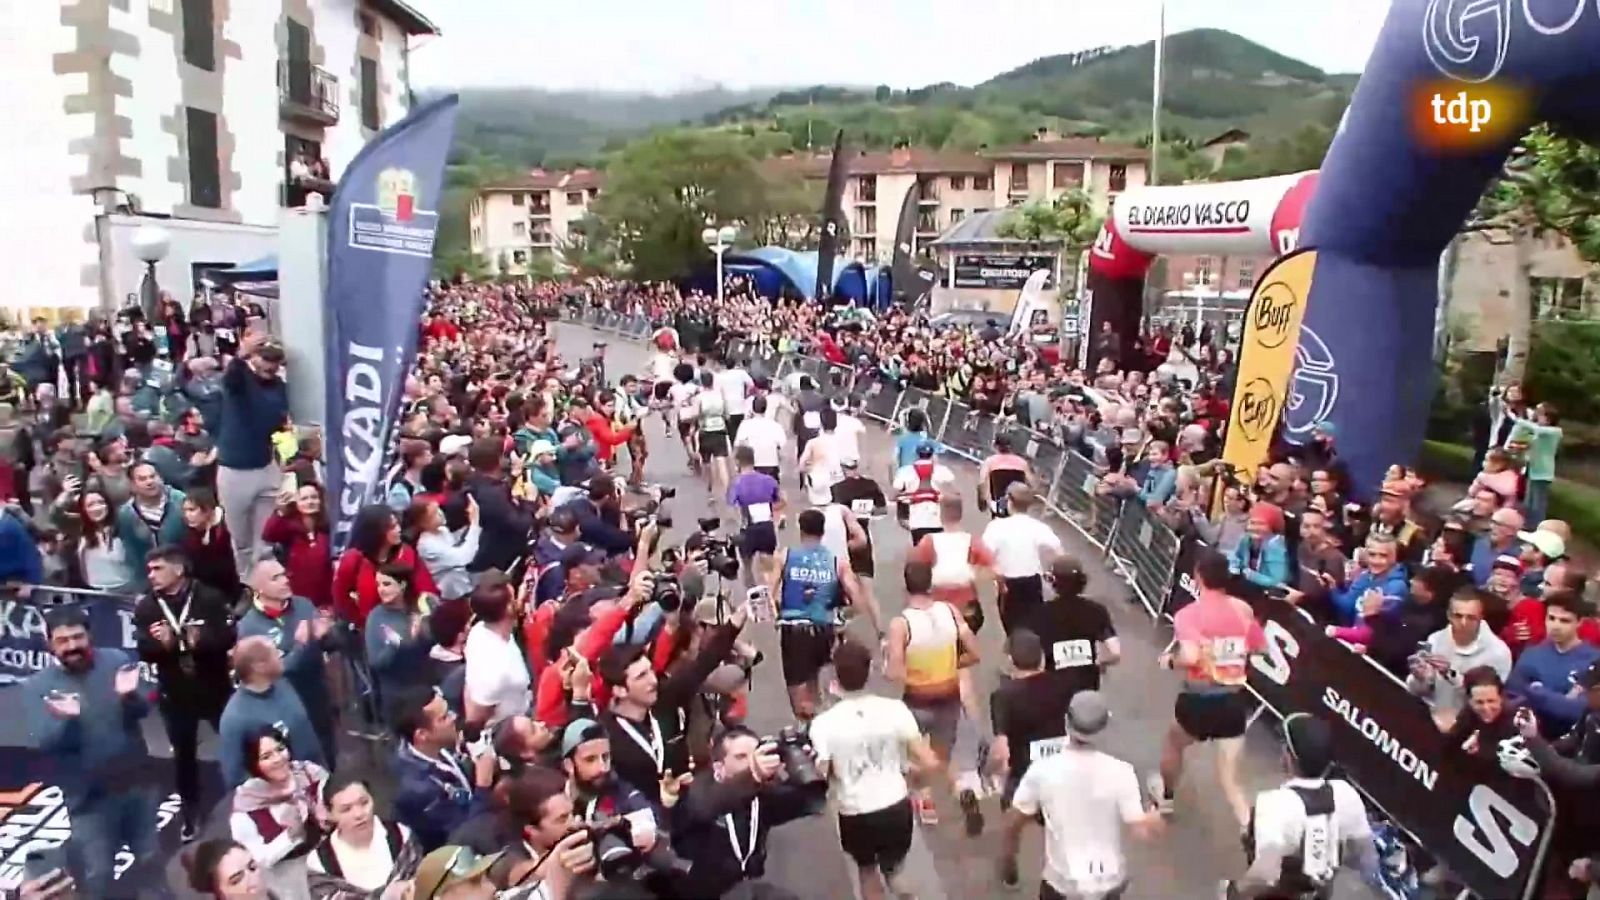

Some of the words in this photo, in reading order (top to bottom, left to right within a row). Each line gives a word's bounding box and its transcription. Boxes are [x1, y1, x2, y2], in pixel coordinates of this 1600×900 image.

[1129, 205, 1141, 225] EL
[1143, 203, 1191, 226] DIARIO
[1195, 199, 1250, 225] VASCO
[1322, 686, 1439, 791] SALOMON
